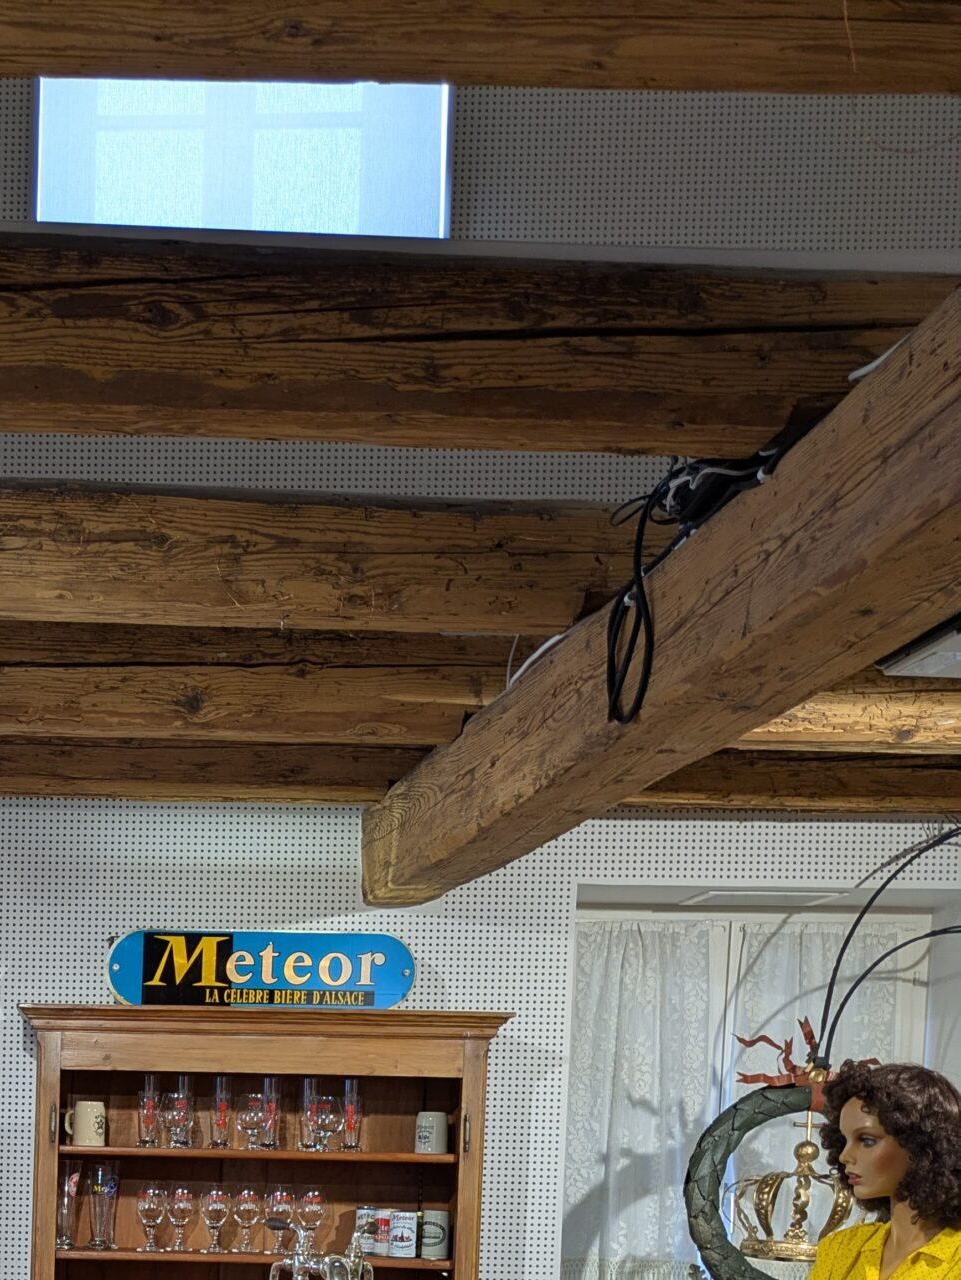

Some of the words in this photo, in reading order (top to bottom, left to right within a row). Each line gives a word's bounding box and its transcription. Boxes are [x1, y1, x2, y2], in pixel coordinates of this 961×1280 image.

[144, 935, 386, 987] Meteor
[205, 988, 220, 1003] LA
[312, 990, 365, 1006] D'ALSACE
